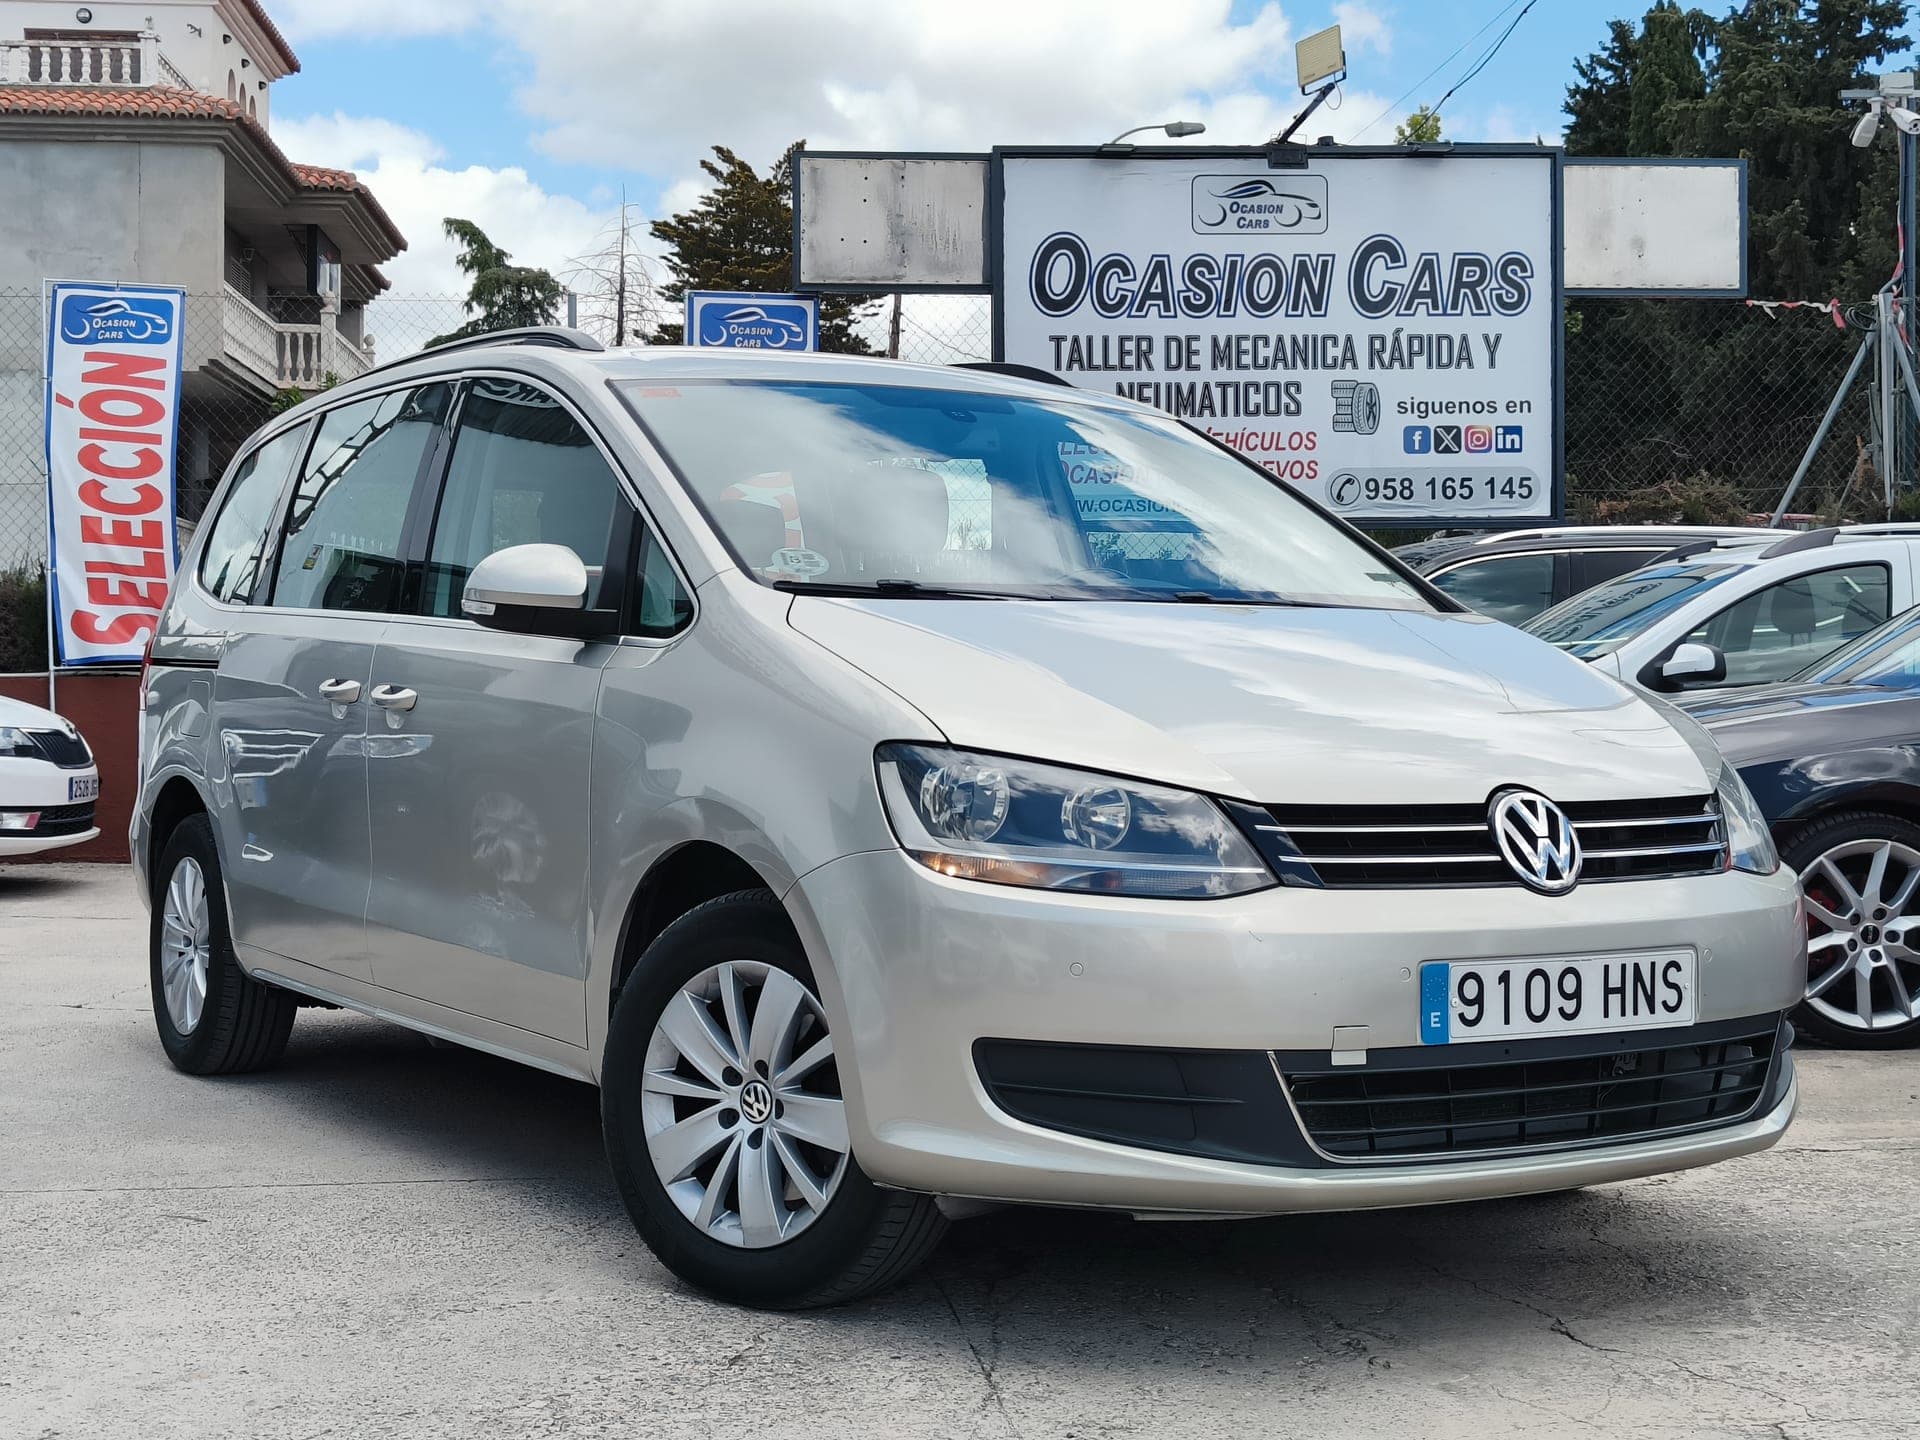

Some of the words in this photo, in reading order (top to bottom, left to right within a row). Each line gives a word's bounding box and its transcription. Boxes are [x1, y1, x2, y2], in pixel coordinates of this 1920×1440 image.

[1229, 201, 1284, 214] OCASION
[1236, 217, 1270, 229] CARS
[1029, 231, 1336, 319] OCASION
[1348, 233, 1534, 319] CARS
[92, 318, 137, 329] OCASION
[729, 324, 774, 336] OCASION
[97, 330, 124, 340] CARS
[735, 337, 761, 348] CARS
[1048, 335, 1154, 371] TALLER
[1164, 334, 1200, 371] DE
[1211, 334, 1359, 370] MECANICA
[1368, 327, 1474, 370] RÁPIDA
[1482, 333, 1502, 369] Y
[1396, 396, 1498, 419] siguenos
[1505, 400, 1532, 414] en
[1206, 427, 1317, 451] HÍCULOS
[1364, 478, 1415, 500] 958
[1425, 477, 1474, 500] 165
[1484, 476, 1533, 500] 145
[56, 351, 168, 645] SELECCIÓN
[1457, 966, 1583, 1028] 9109
[1603, 960, 1684, 1019] HNS
[1430, 1012, 1441, 1028] E
